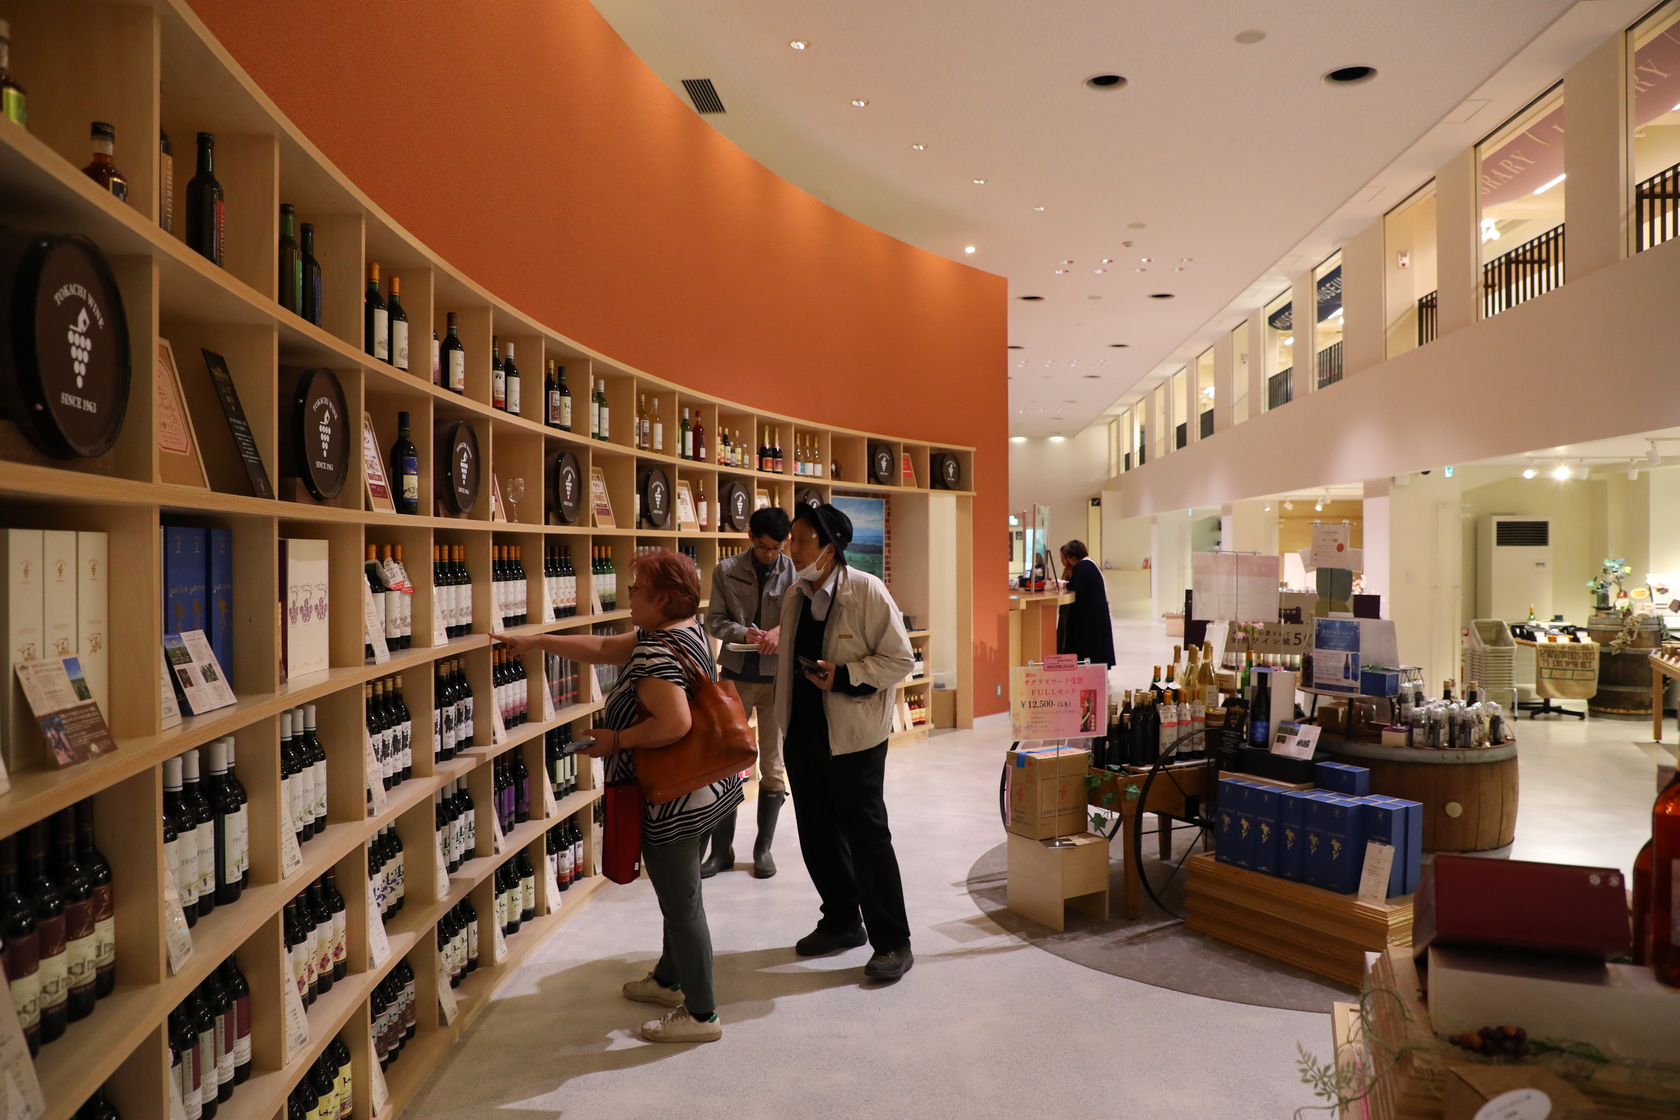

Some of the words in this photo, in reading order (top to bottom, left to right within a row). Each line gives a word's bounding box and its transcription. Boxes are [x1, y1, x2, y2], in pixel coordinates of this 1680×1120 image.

[54, 283, 87, 306] TOKACHI
[87, 293, 104, 329] WINE
[61, 392, 82, 410] SINCE
[83, 399, 97, 413] 1963
[1024, 677, 1083, 686] サクラアワード受賞
